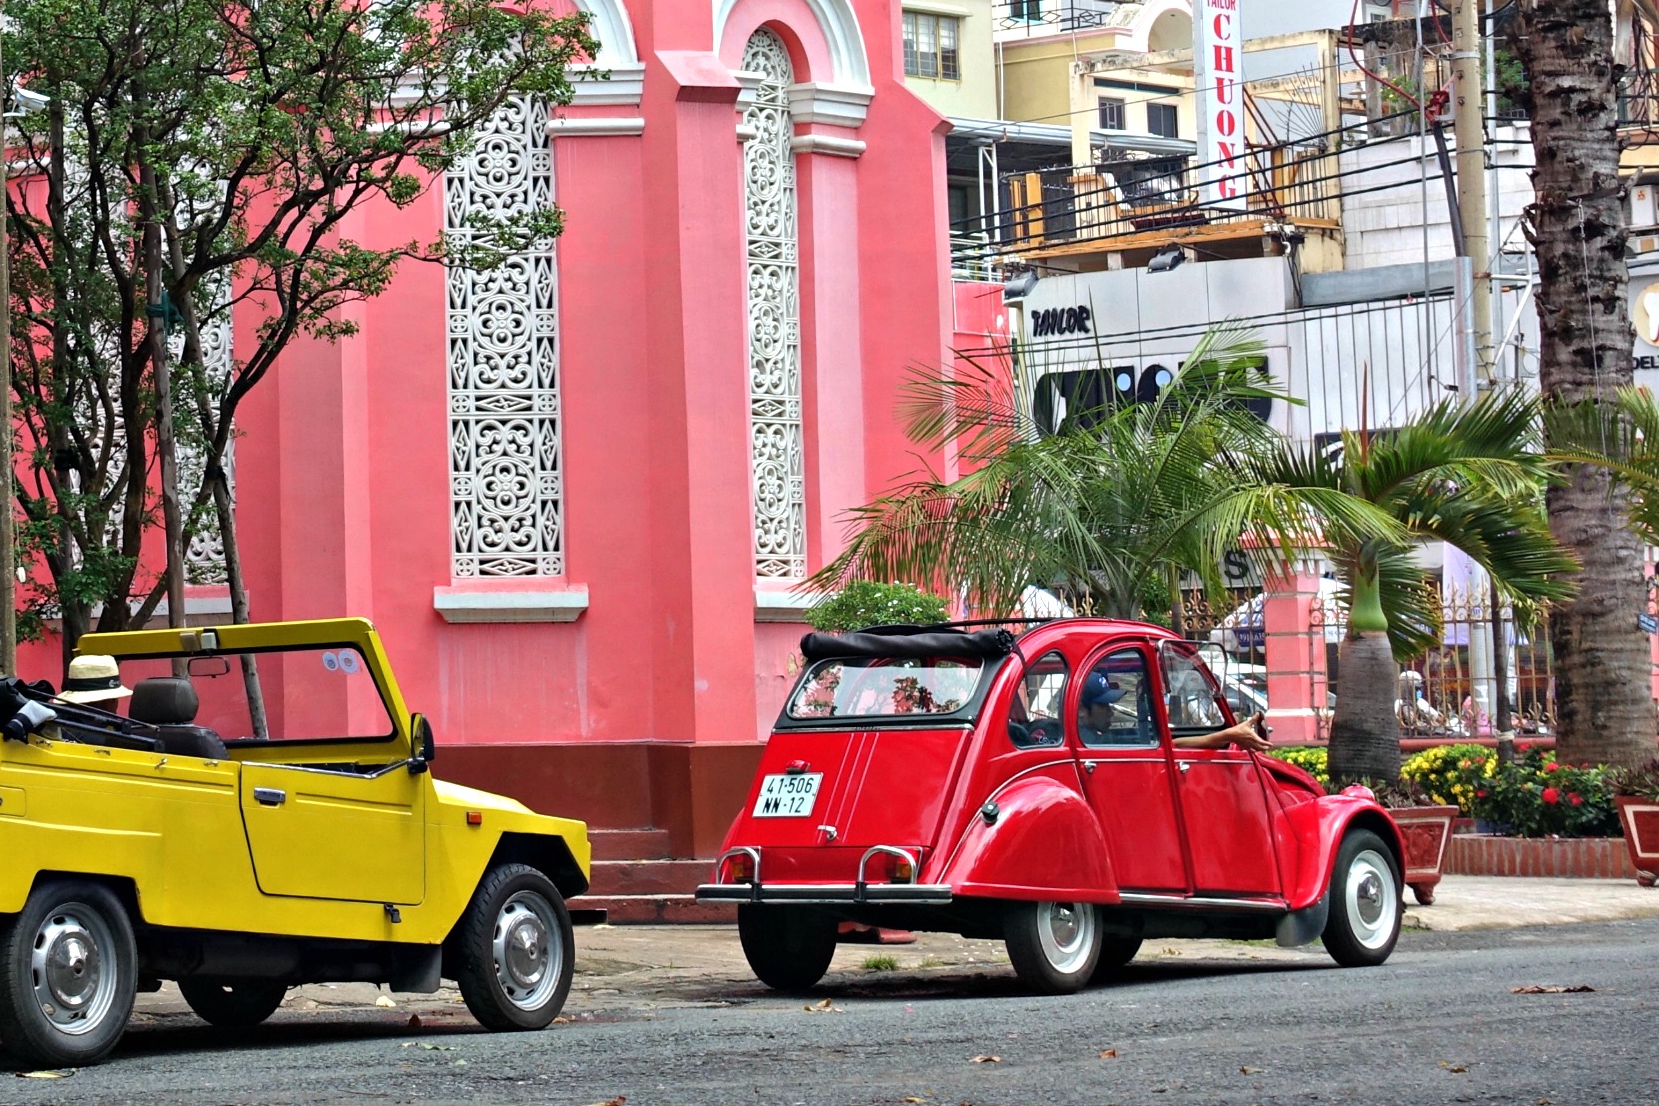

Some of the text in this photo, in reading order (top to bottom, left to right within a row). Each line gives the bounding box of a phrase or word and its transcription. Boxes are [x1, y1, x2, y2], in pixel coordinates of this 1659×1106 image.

[1213, 13, 1237, 201] CHUONG
[1031, 305, 1091, 337] TAILOR
[766, 777, 815, 794] 41-506
